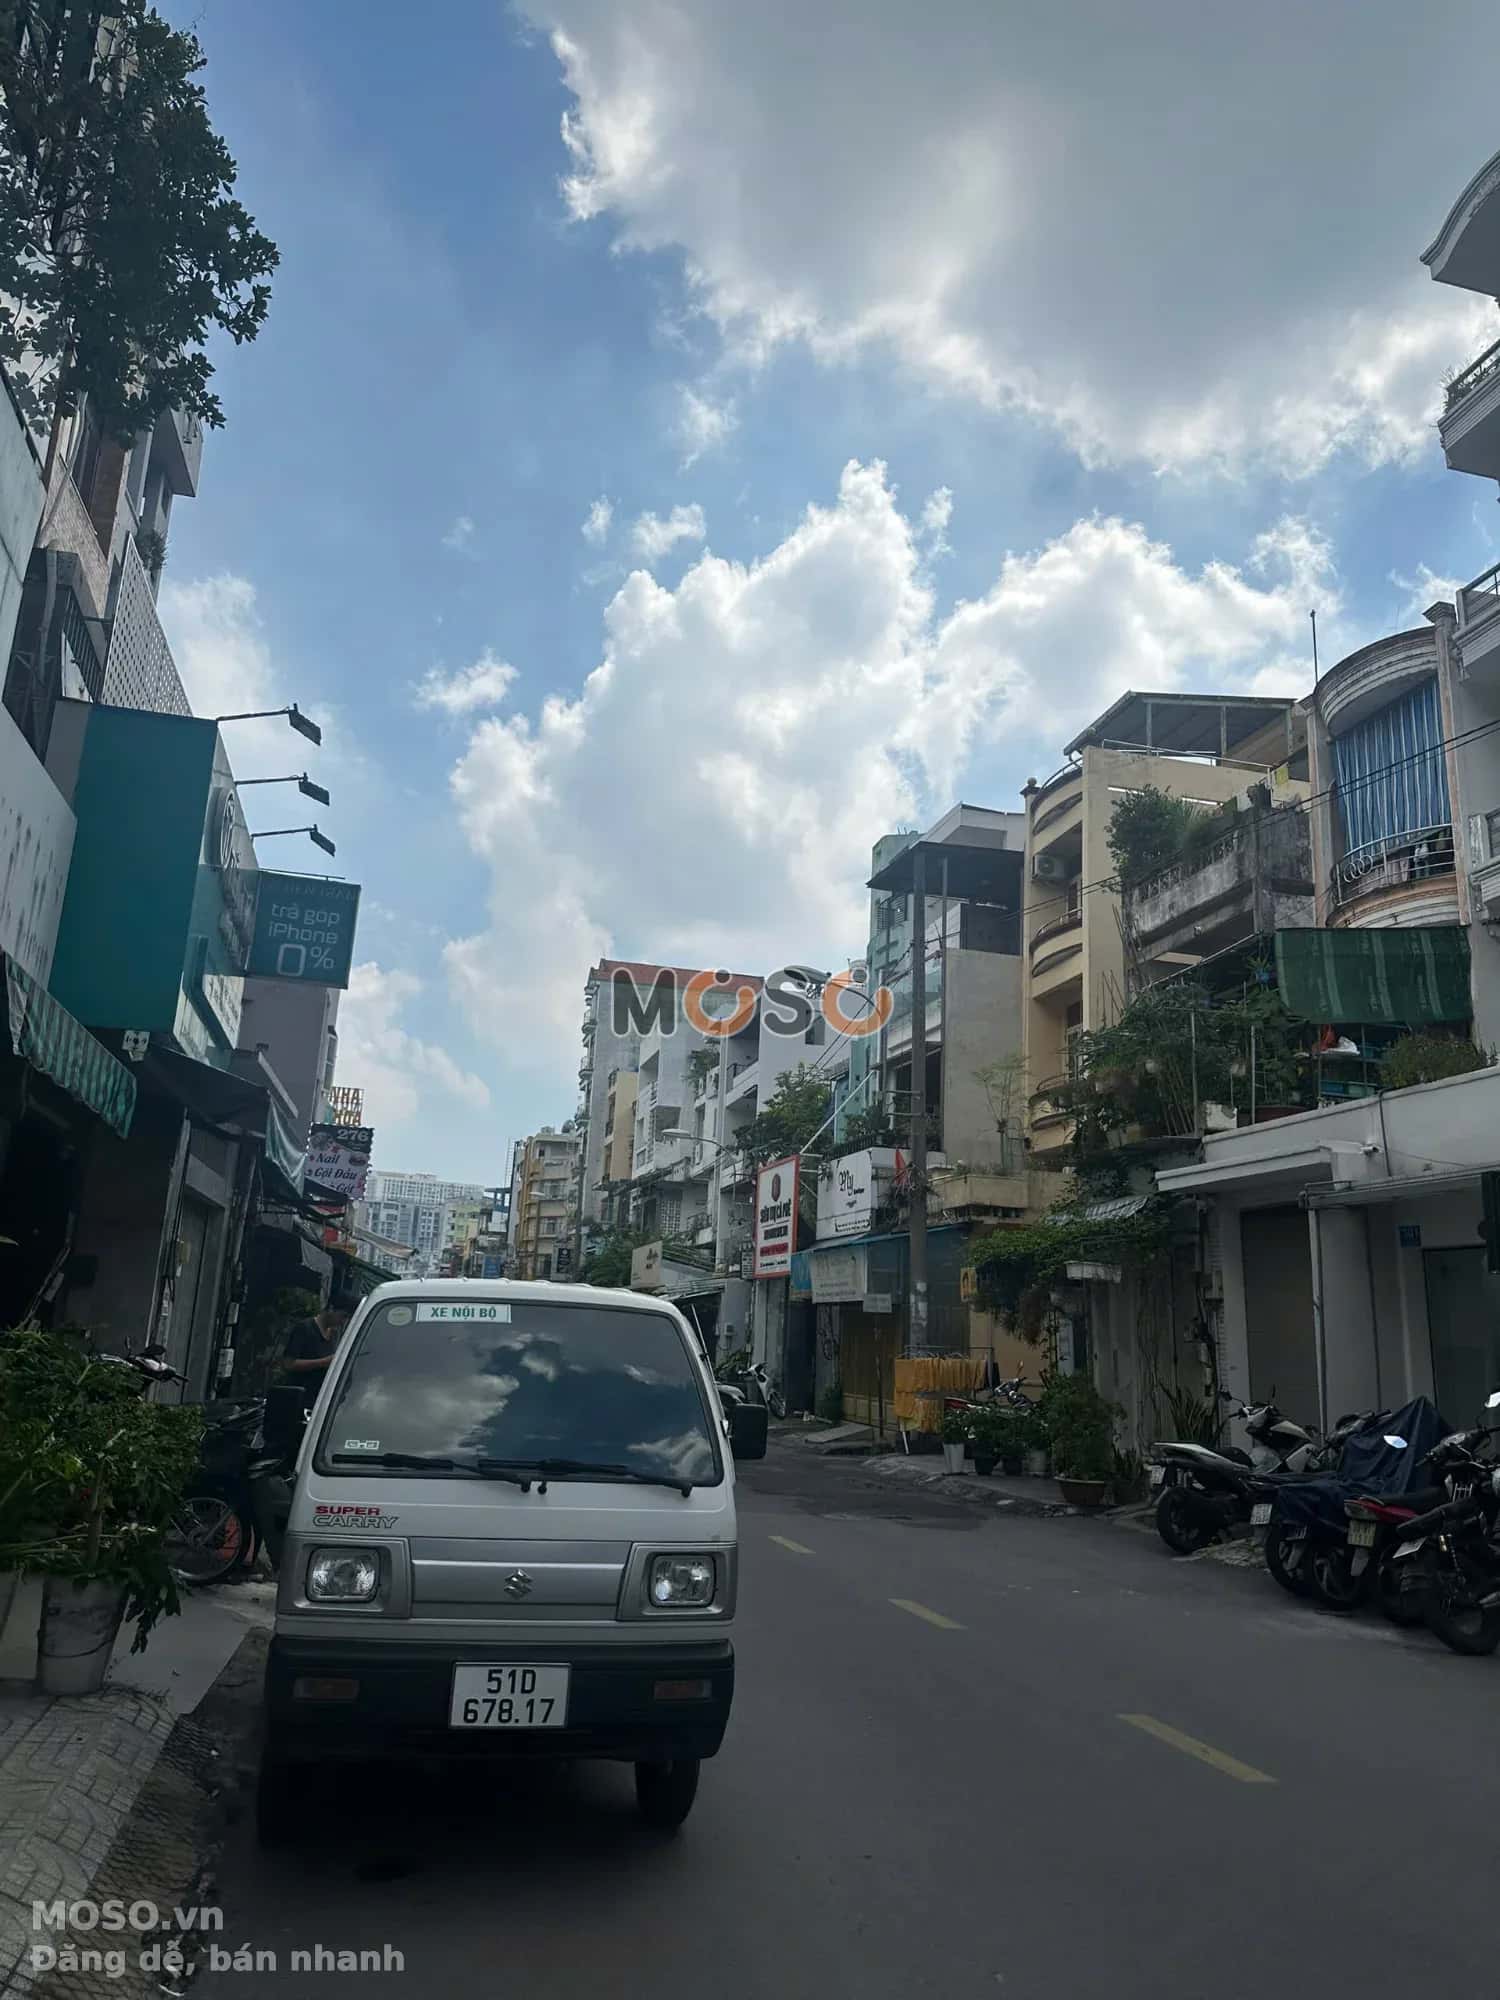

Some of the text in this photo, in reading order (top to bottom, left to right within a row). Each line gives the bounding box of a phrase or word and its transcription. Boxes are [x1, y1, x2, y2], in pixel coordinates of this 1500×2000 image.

[268, 921, 339, 944] iPhone
[277, 943, 335, 977] 0%
[336, 1129, 369, 1142] 276
[316, 1152, 341, 1164] Nail
[430, 1305, 497, 1320] XE NỘI BỘ
[315, 1505, 381, 1516] SUPER
[313, 1514, 400, 1529] CARRY
[487, 1668, 537, 1695] 51D
[463, 1698, 556, 1724] 678.17
